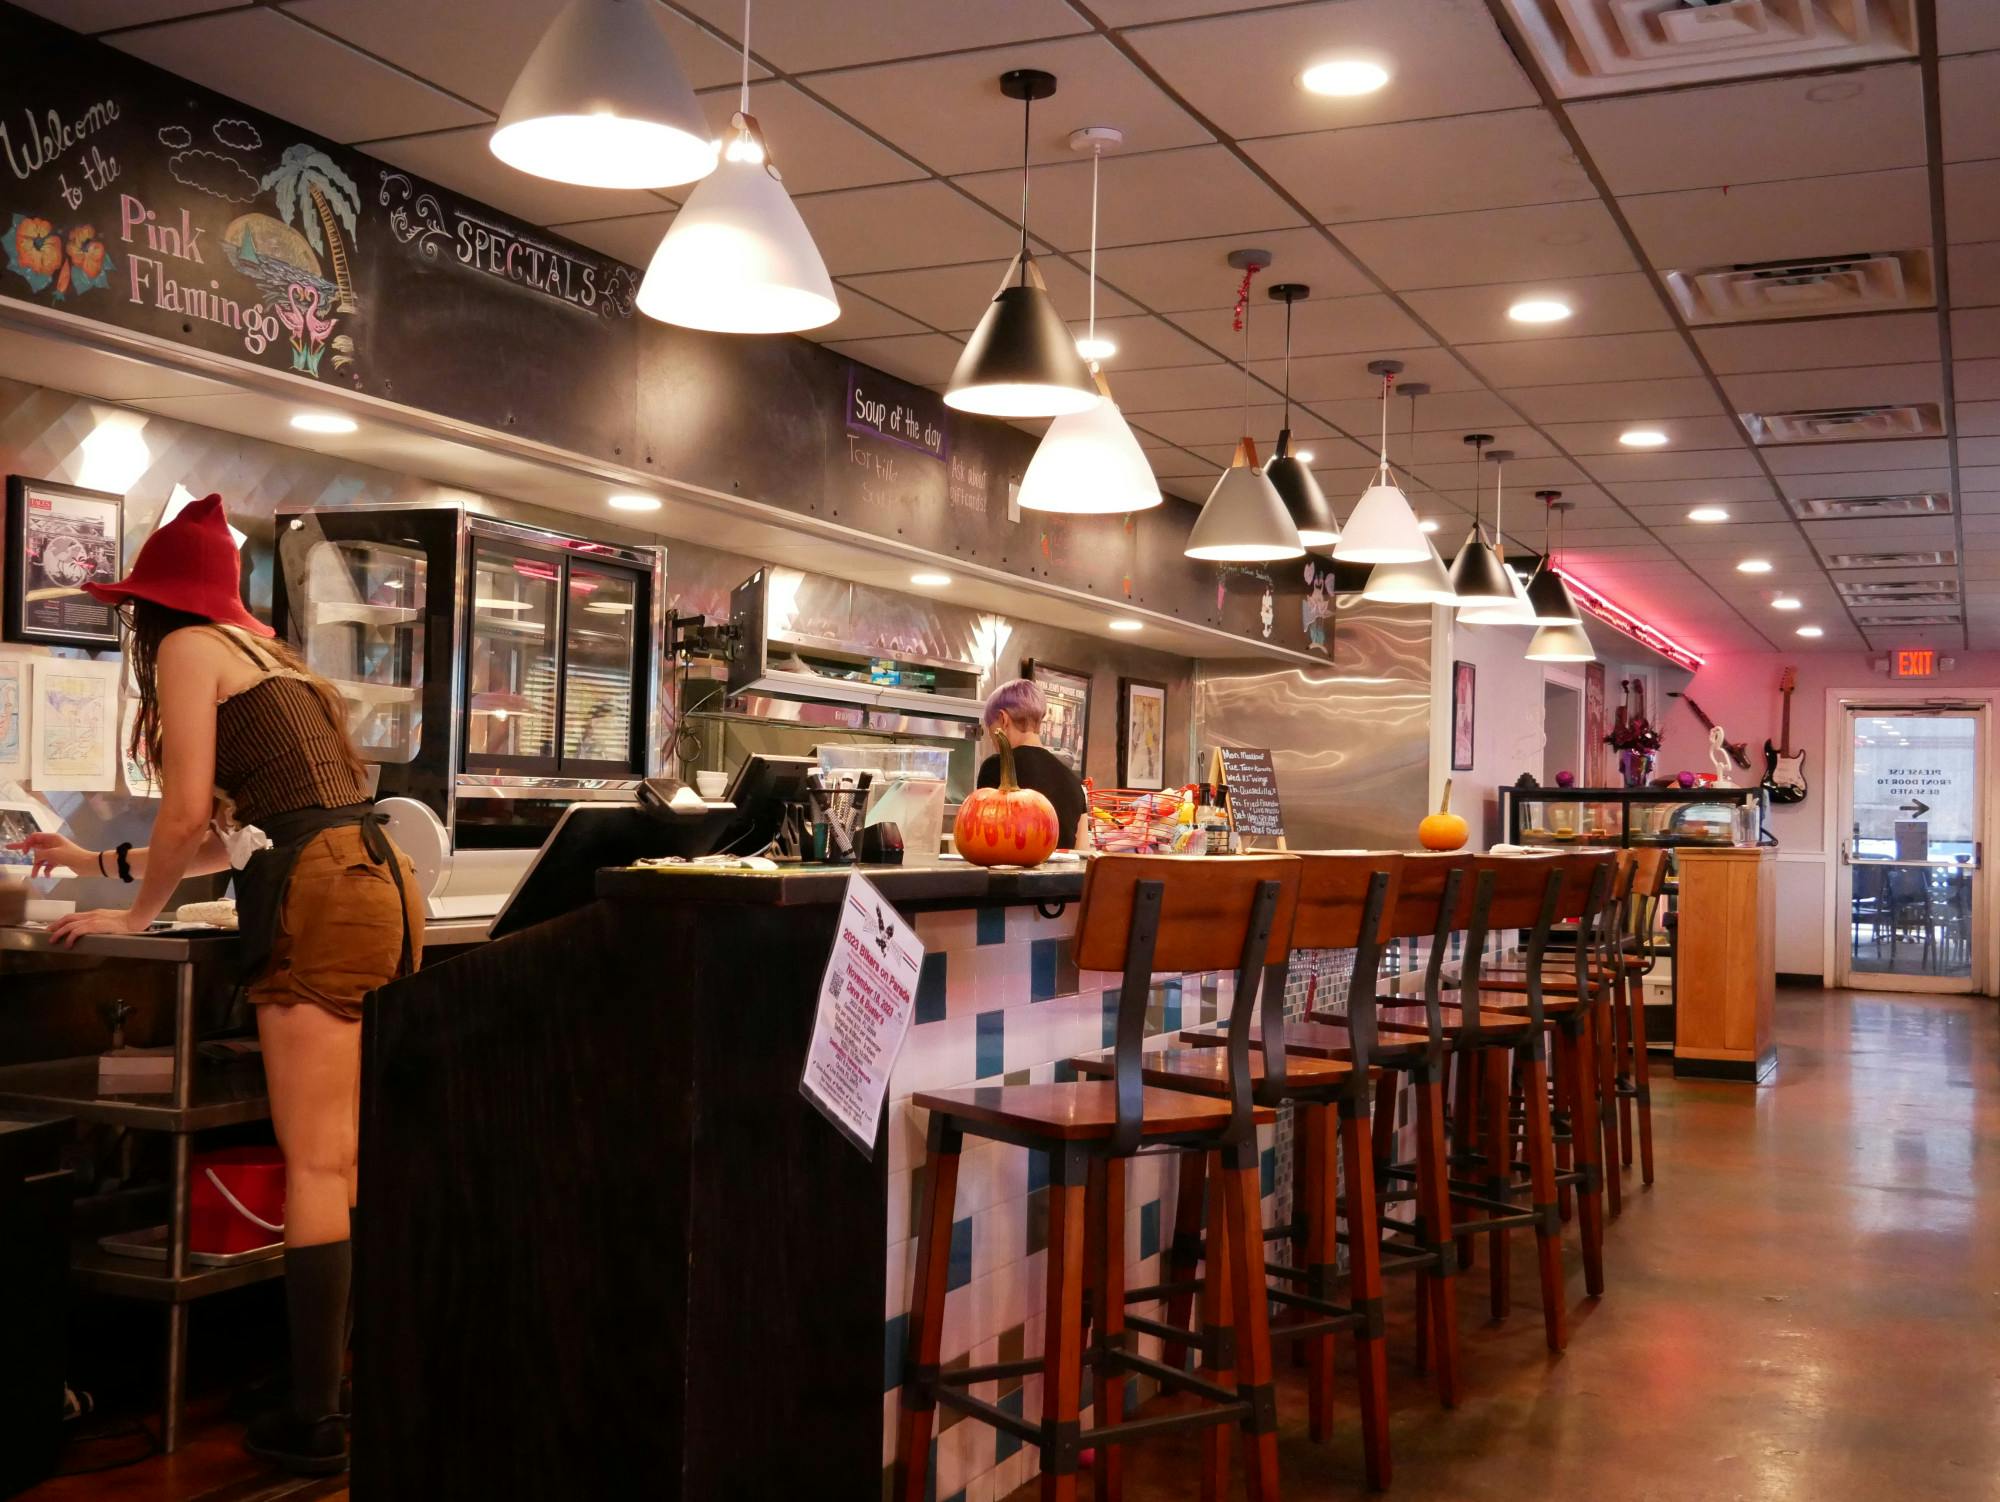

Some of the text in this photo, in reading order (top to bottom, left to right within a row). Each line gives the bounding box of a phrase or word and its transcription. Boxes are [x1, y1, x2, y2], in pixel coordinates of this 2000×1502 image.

[0, 99, 120, 180] Welcome
[58, 146, 121, 210] to the
[119, 194, 206, 265] Pink
[457, 220, 596, 306] SPECIALS
[127, 254, 279, 355] Flamingo
[855, 388, 942, 454] Soup of the day
[952, 456, 965, 483] Ask
[1899, 651, 1934, 676] EXIT
[843, 926, 910, 1004] 2023 Bikers on Parade
[846, 961, 873, 997] November
[846, 980, 860, 1000] Dave
[864, 998, 884, 1025] Buster's
